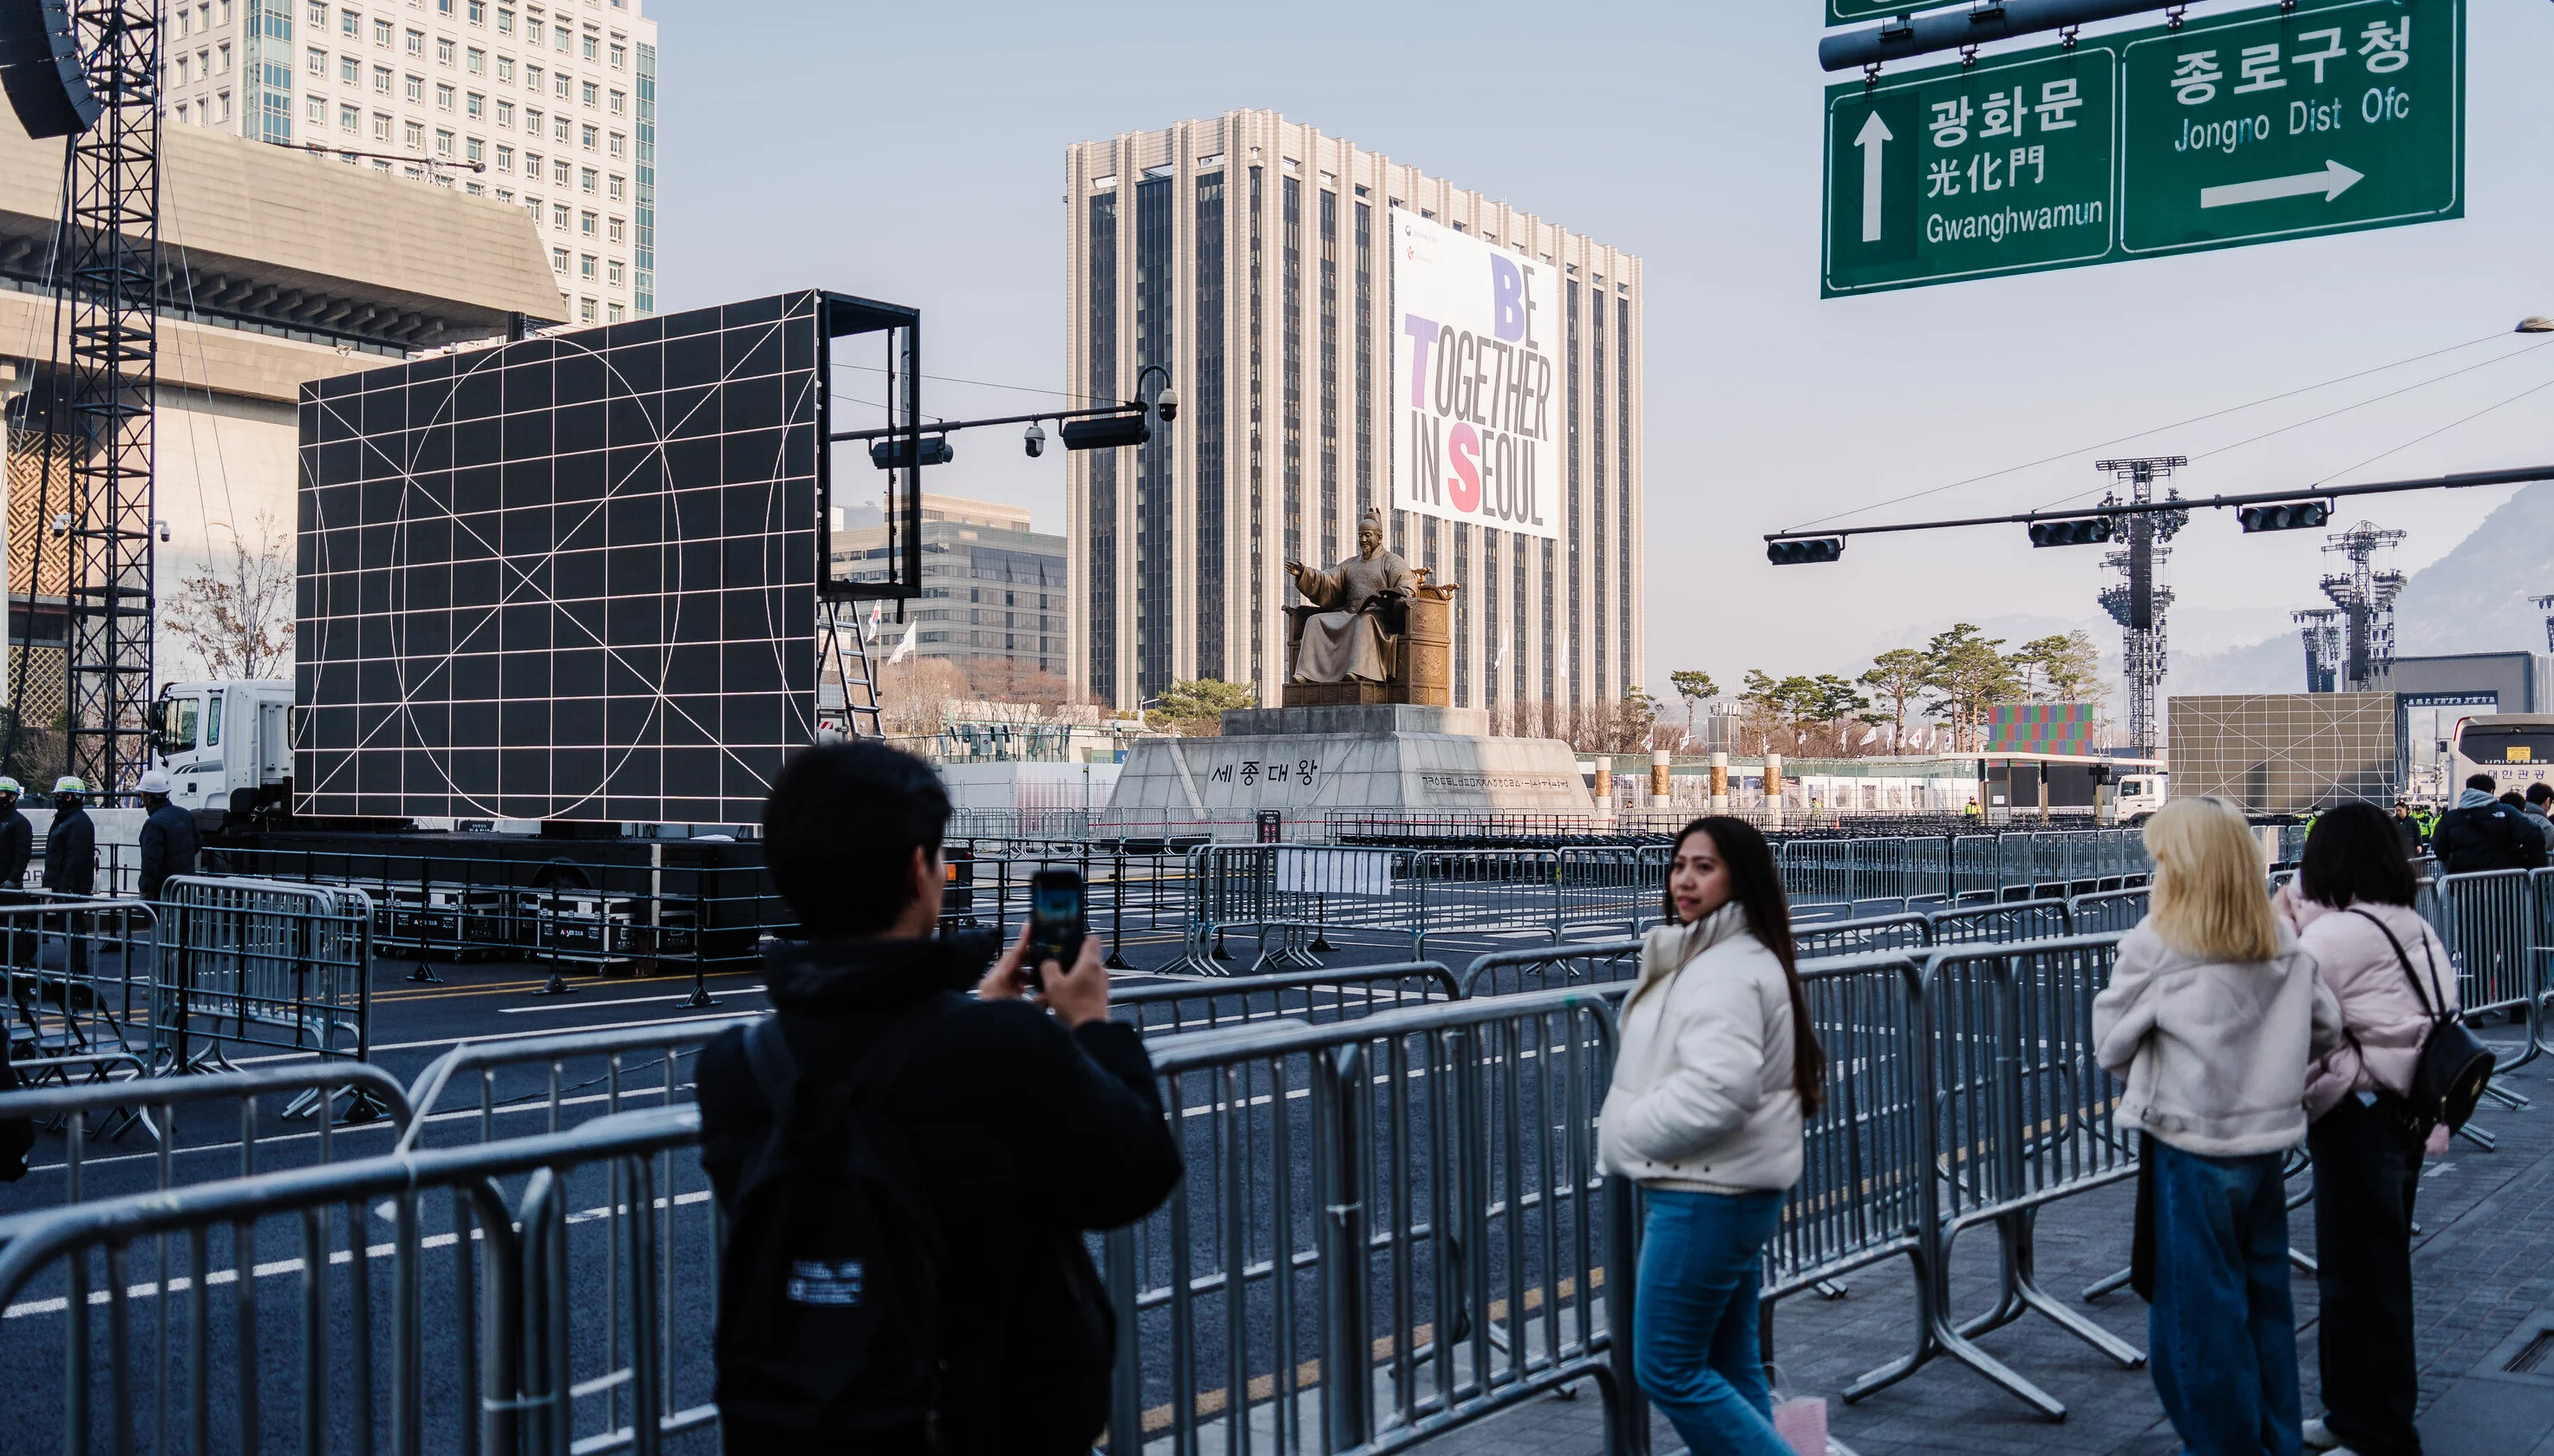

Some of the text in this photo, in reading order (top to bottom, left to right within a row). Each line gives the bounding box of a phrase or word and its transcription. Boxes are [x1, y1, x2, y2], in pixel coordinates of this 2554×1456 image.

[2171, 16, 2410, 105] 종로구청
[1929, 78, 2083, 147] 광화문
[2174, 87, 2410, 153] Jongno Dist Ofc
[1927, 145, 2044, 199] 光化門
[1926, 200, 2103, 243] Gwanghwamun
[1490, 252, 1538, 351] BE
[1405, 313, 1551, 442] TOGETHER
[1411, 410, 1544, 526] IN SEOUL
[1212, 759, 1317, 787] 세종대왕
[2487, 769, 2545, 780] 대한관광
